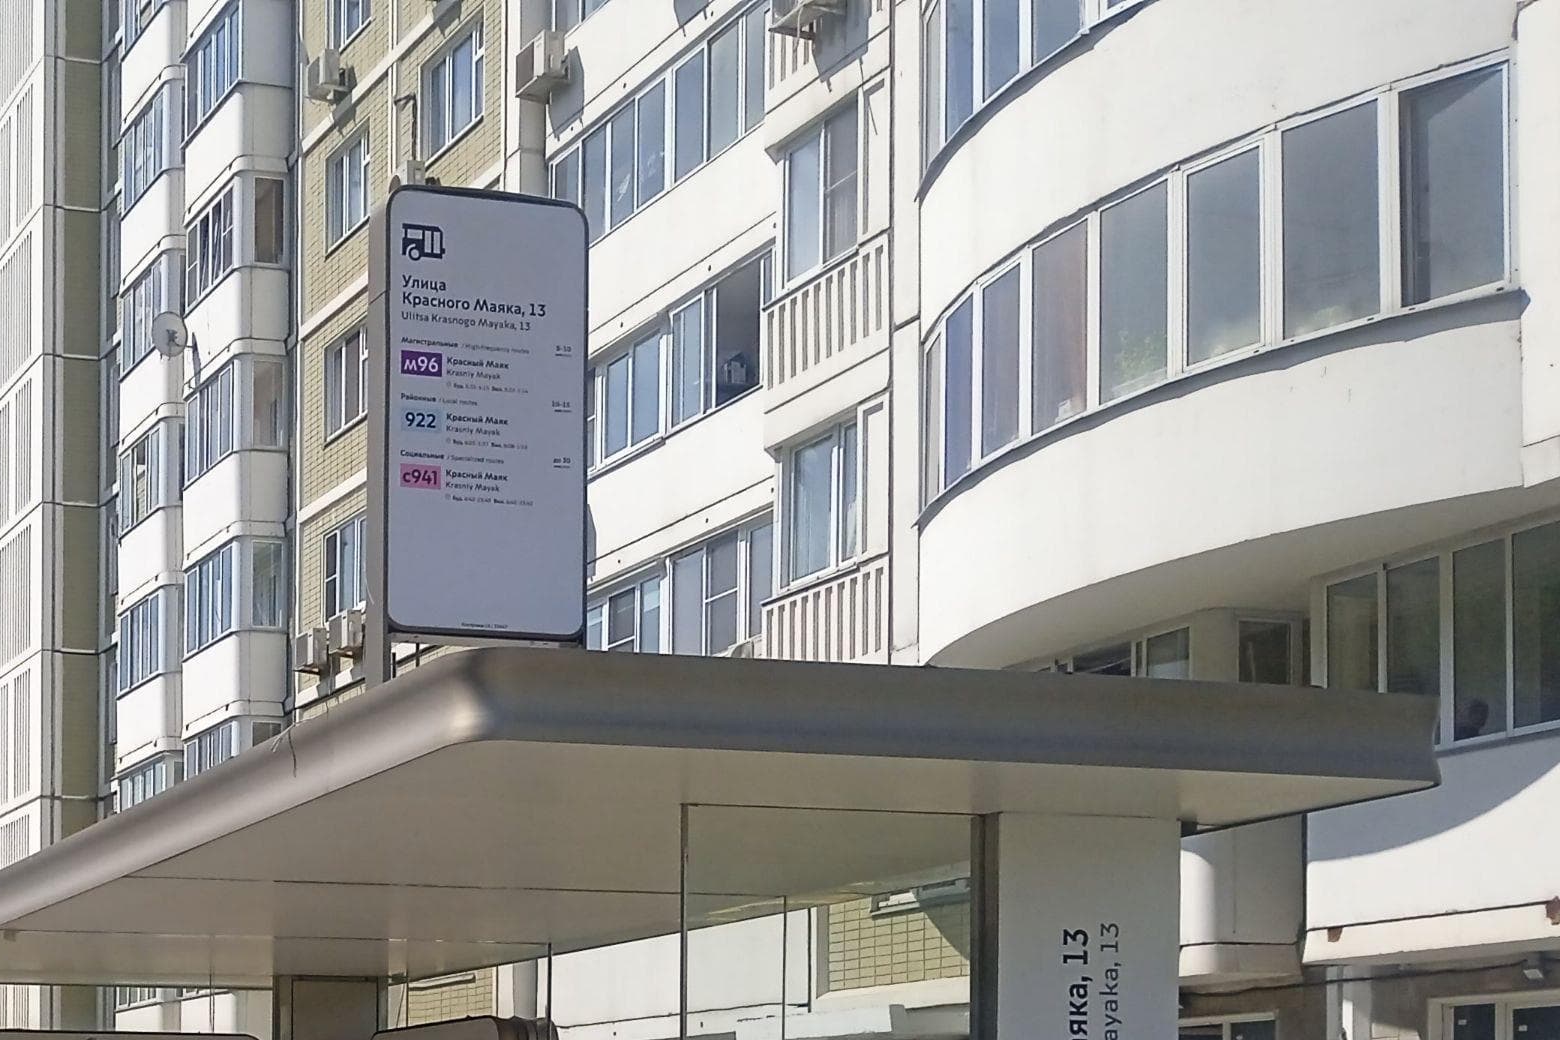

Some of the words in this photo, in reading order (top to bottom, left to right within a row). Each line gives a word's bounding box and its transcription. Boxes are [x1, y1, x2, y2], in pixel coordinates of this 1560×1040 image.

[402, 275, 447, 292] Улица
[402, 292, 470, 312] Красного
[473, 299, 525, 317] Маяка,
[529, 303, 546, 317] 13
[401, 311, 430, 322] Ulitsa
[431, 314, 476, 328] Krasnogo
[478, 319, 517, 331] Mayaka,
[520, 322, 531, 331] 13
[447, 356, 484, 369] Красный
[485, 360, 509, 370] Маяк
[405, 412, 436, 429] 922
[446, 413, 484, 425] Красный
[485, 416, 509, 426] Маяк
[445, 469, 483, 481] Красный
[484, 472, 508, 482] Маяк
[1100, 922, 1119, 952] 13
[1062, 928, 1089, 965] 13
